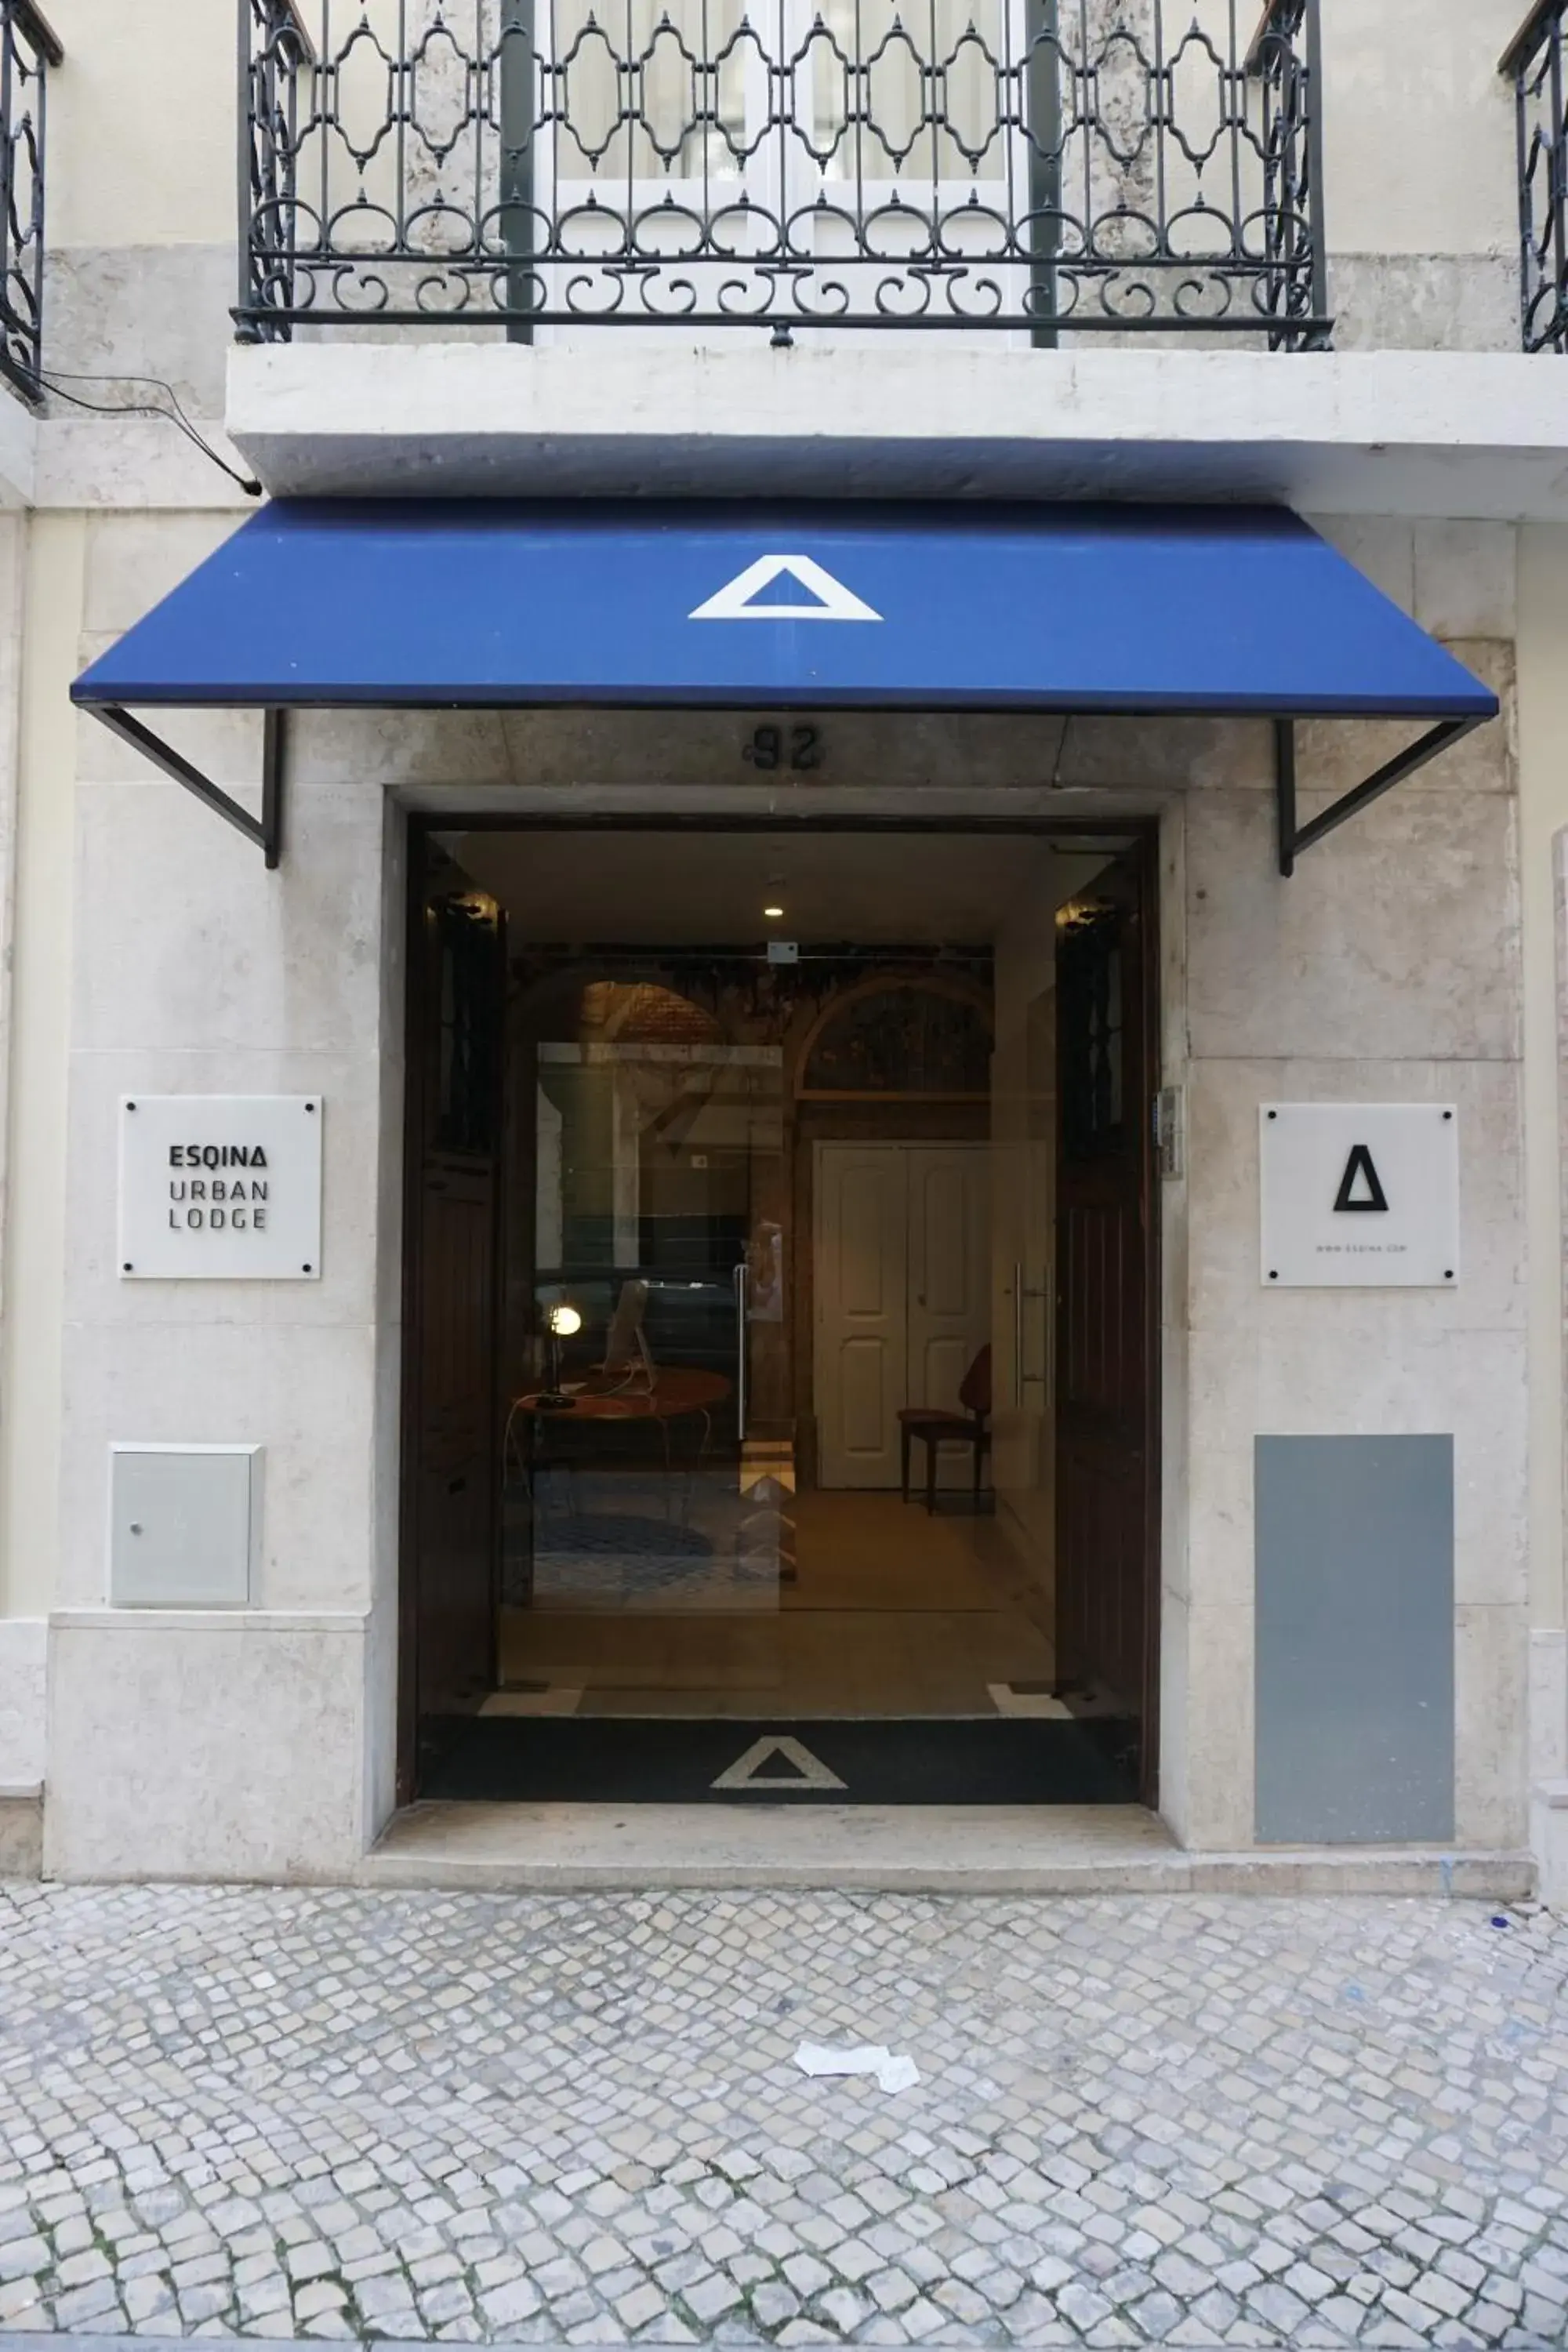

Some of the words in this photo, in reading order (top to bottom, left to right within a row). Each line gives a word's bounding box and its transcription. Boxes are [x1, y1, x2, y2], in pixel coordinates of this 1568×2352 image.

[753, 725, 821, 771] 92
[169, 1145, 267, 1170] ESQINA
[169, 1180, 268, 1201] URBAN
[169, 1208, 267, 1229] LODGE
